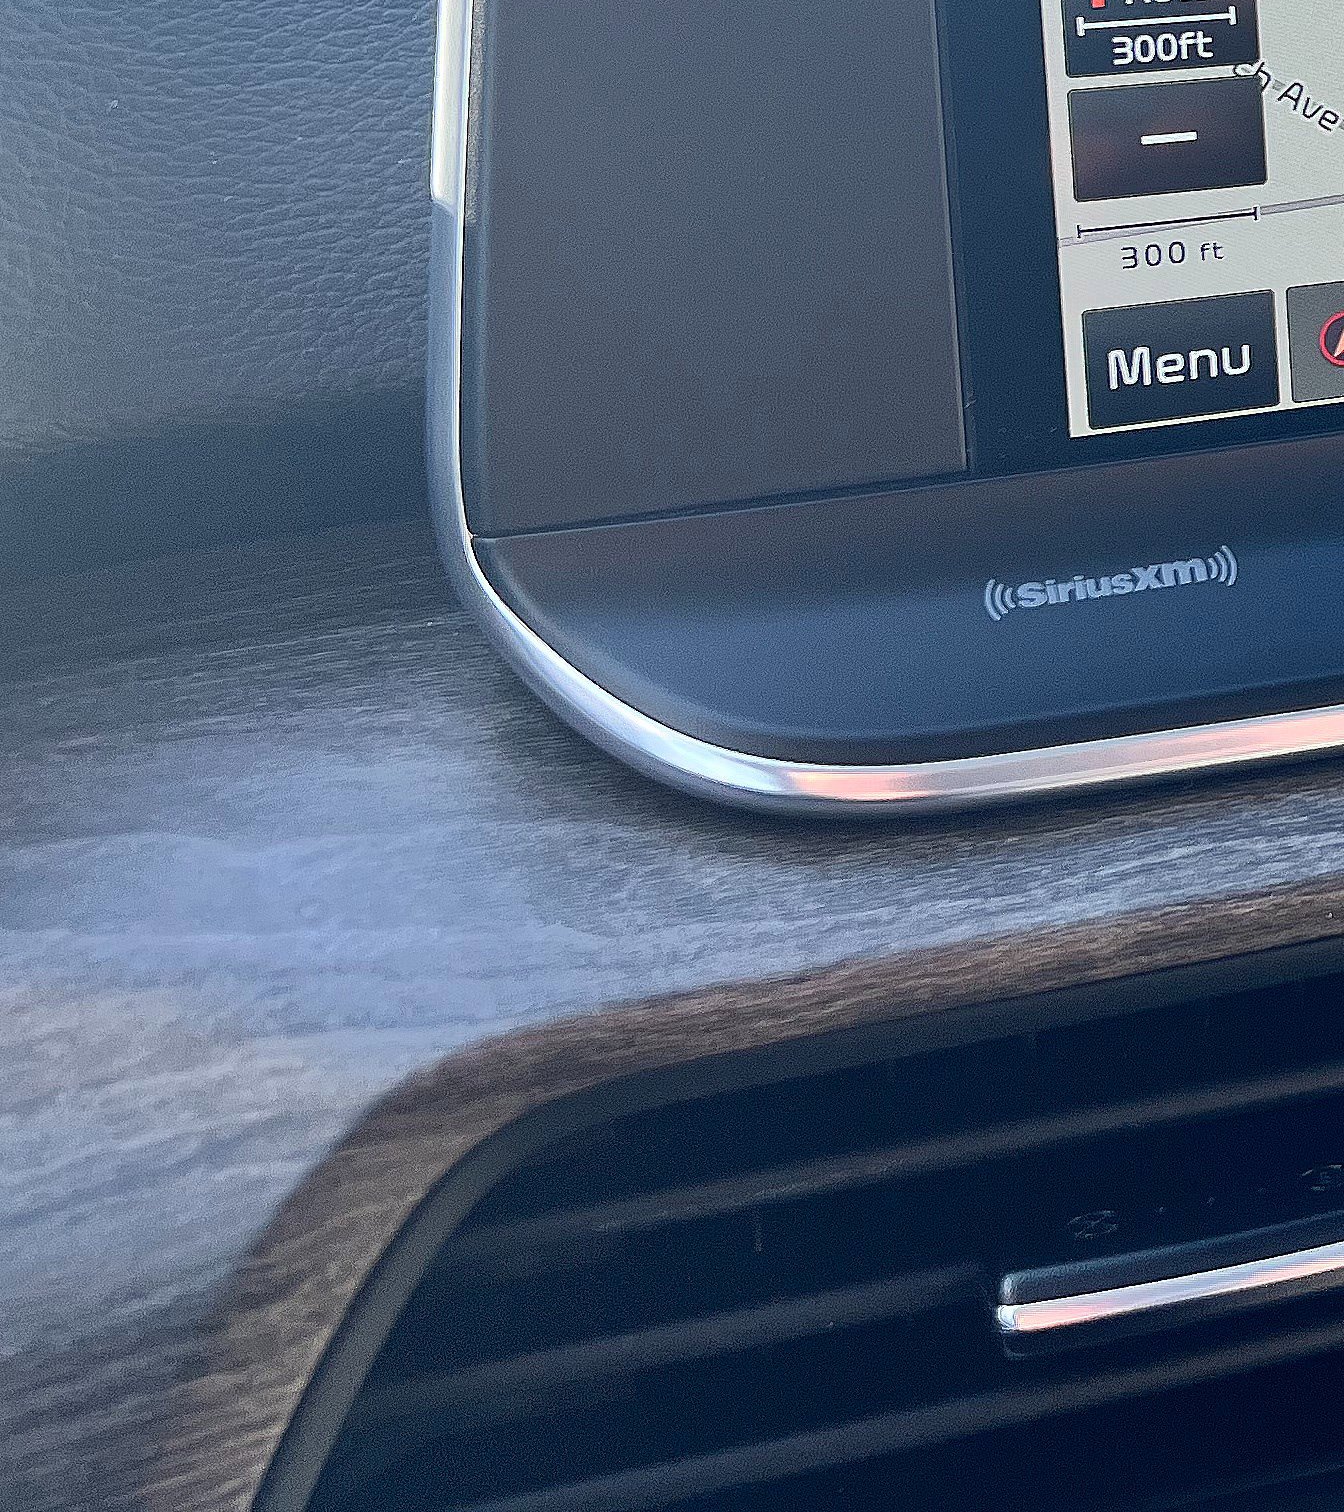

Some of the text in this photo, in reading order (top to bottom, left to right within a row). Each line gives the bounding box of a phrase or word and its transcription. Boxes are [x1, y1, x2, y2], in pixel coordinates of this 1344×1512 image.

[1277, 82, 1340, 133] Ave
[1120, 241, 1225, 269] 300 ft
[1108, 343, 1252, 389] Menu
